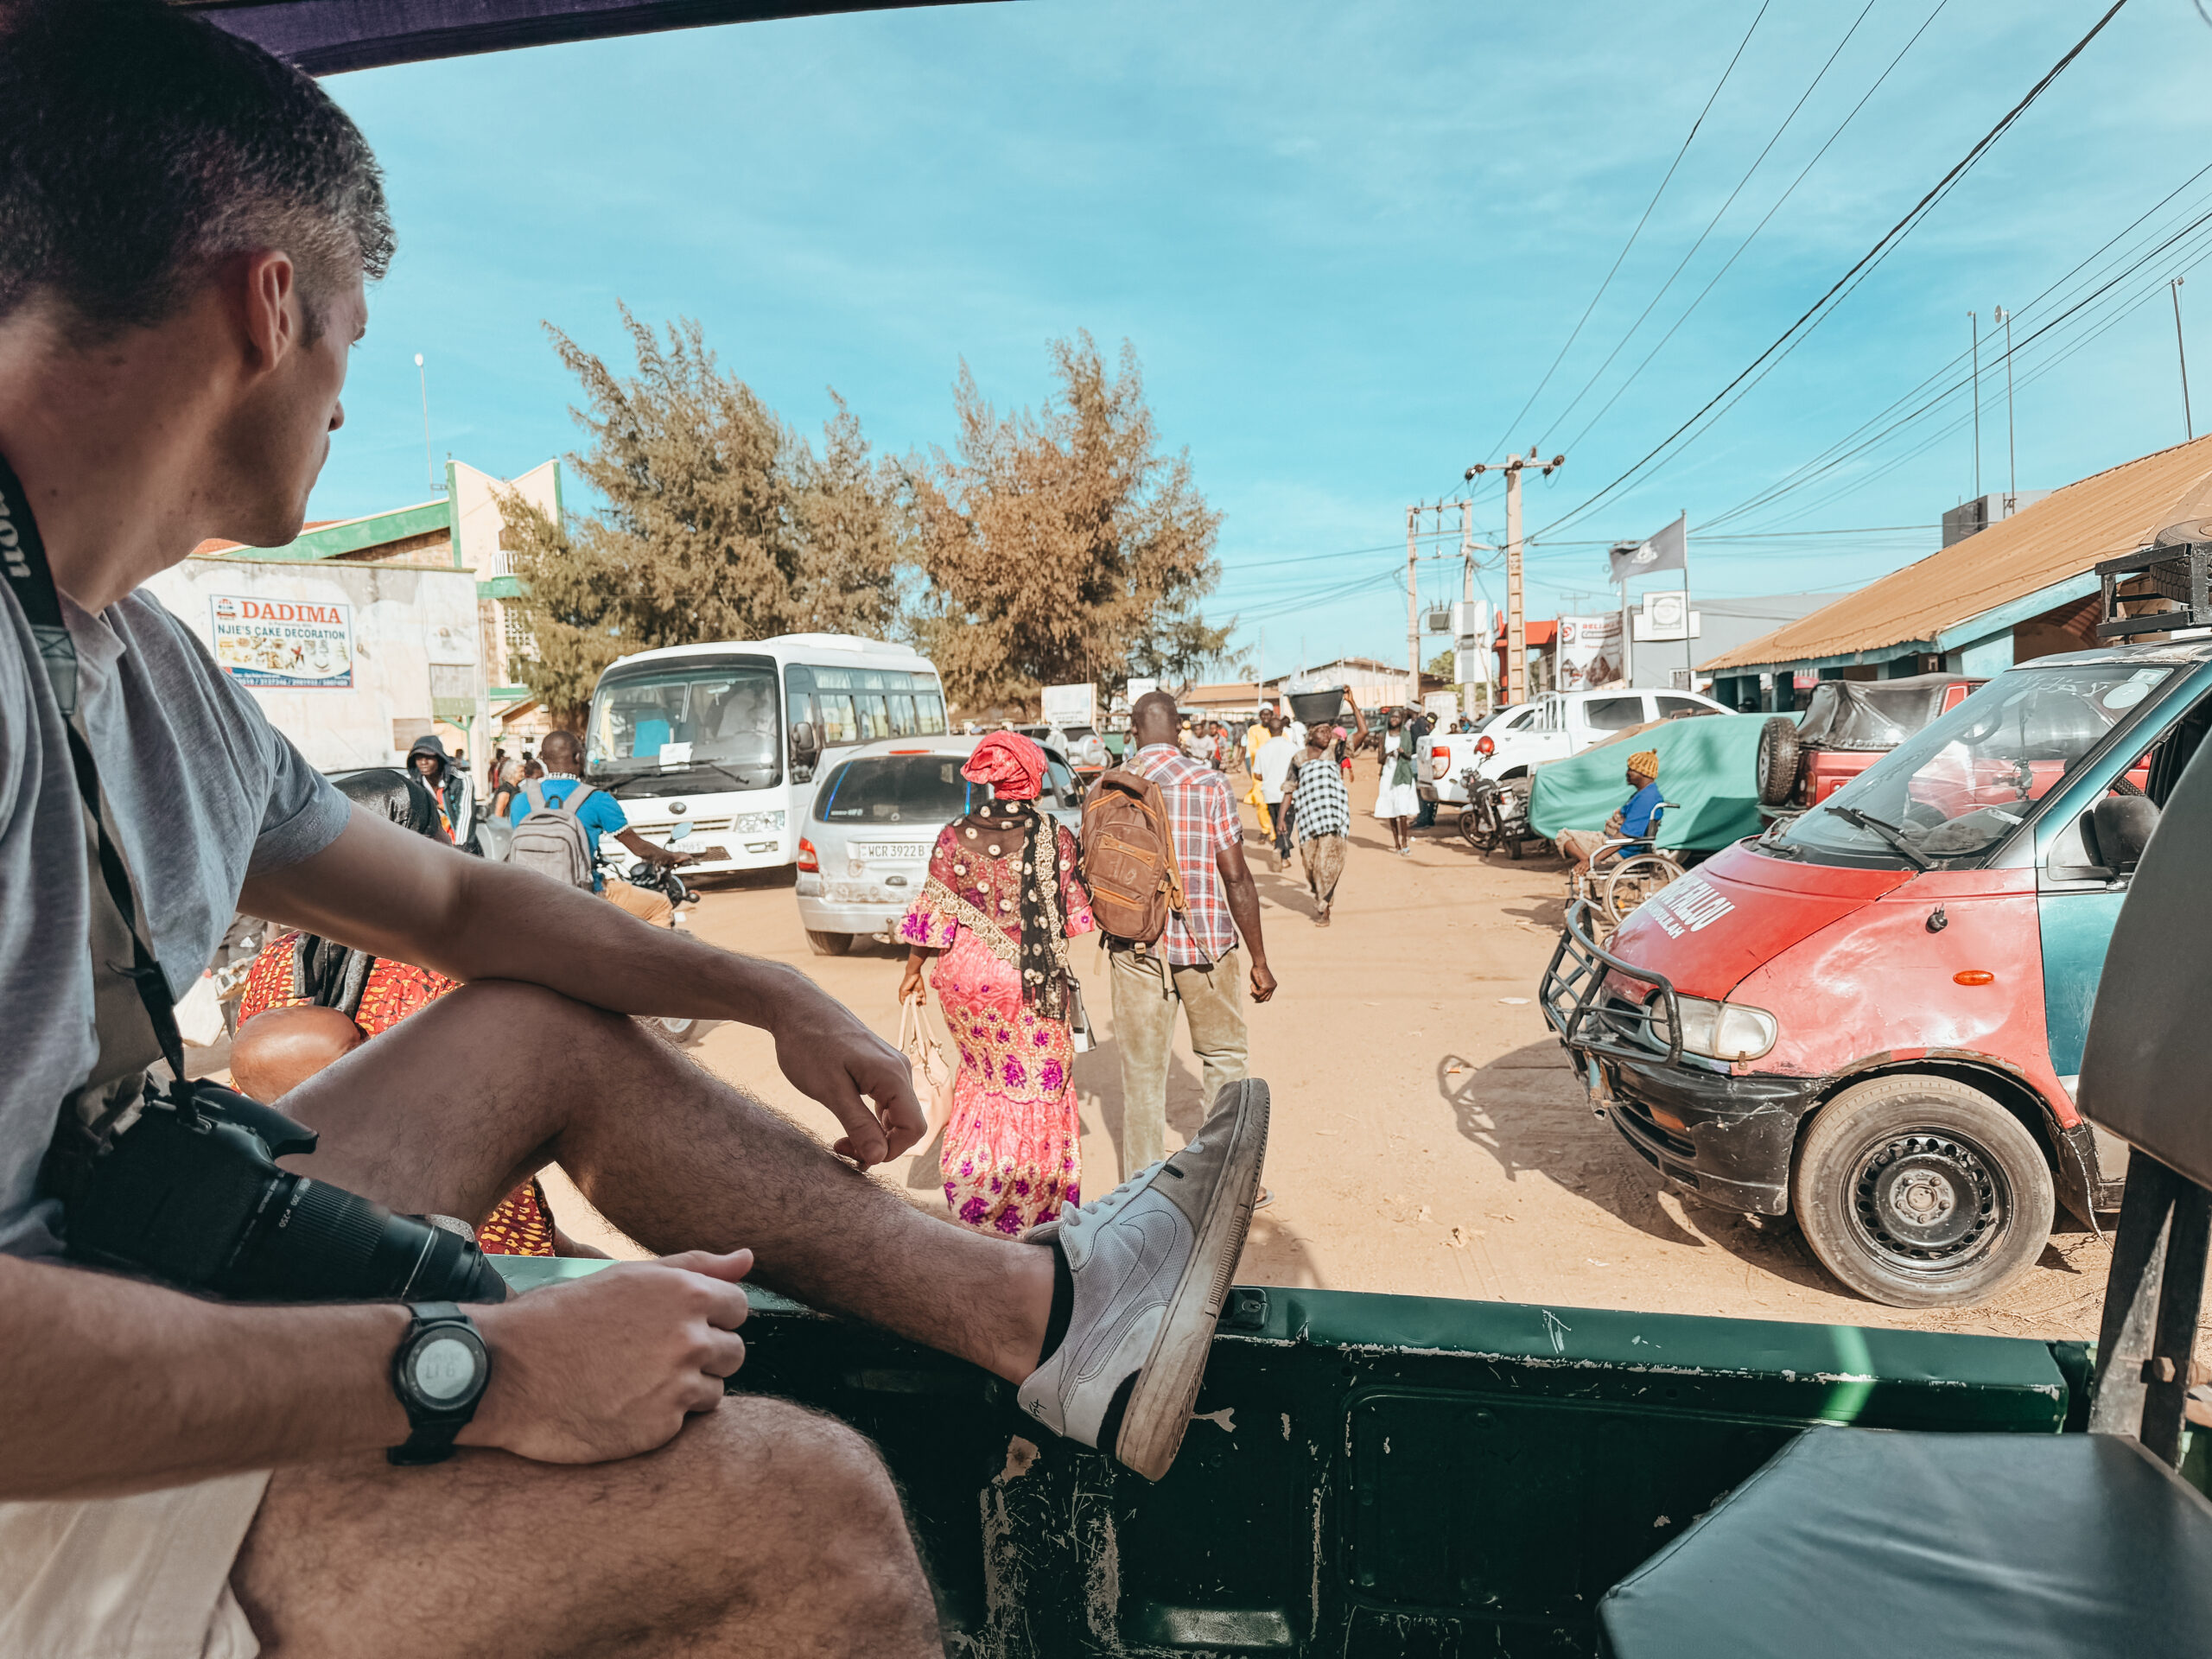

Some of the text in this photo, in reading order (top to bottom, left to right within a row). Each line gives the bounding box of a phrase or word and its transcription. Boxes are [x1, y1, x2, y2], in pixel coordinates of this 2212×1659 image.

[240, 601, 343, 624] DADIMA
[218, 625, 346, 639] NJIE'S CAKE DECORATION
[868, 845, 925, 857] WCR 3922 B
[1668, 881, 1736, 932] FALLOU
